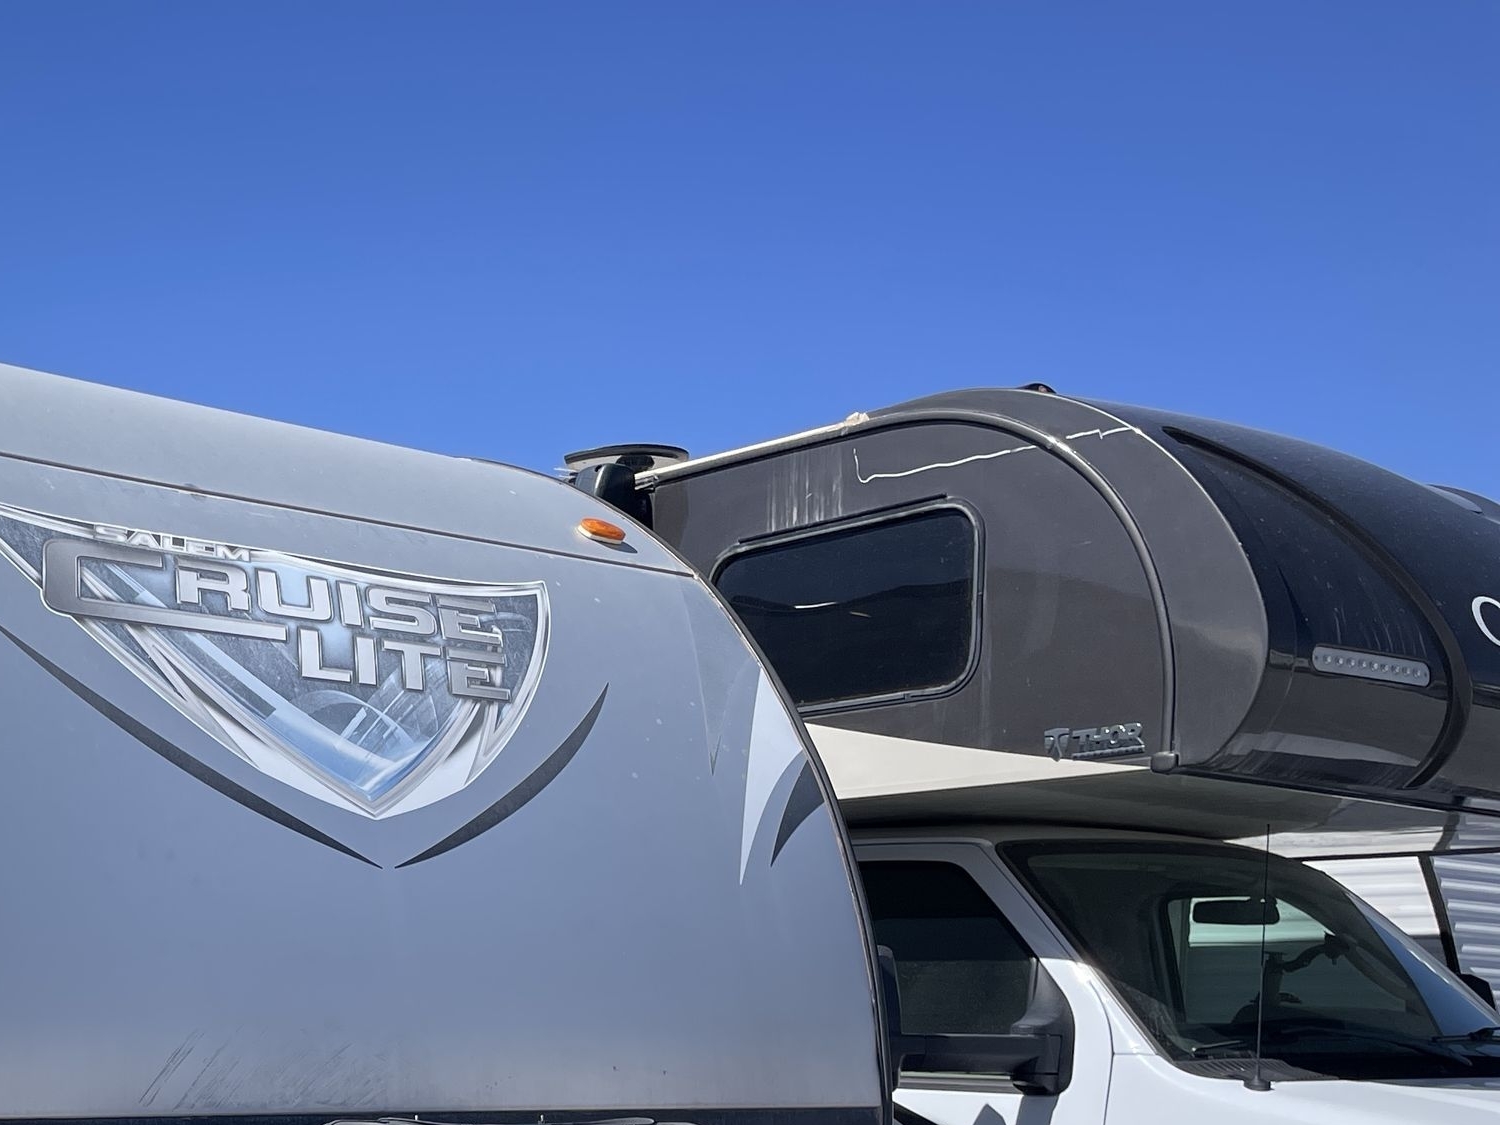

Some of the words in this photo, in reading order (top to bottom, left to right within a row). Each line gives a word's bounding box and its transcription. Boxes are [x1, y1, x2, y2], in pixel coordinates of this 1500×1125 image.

[94, 525, 250, 563] SALEM
[43, 538, 504, 648] CRUISE
[299, 626, 511, 702] LITE
[1072, 723, 1143, 752] THOR
